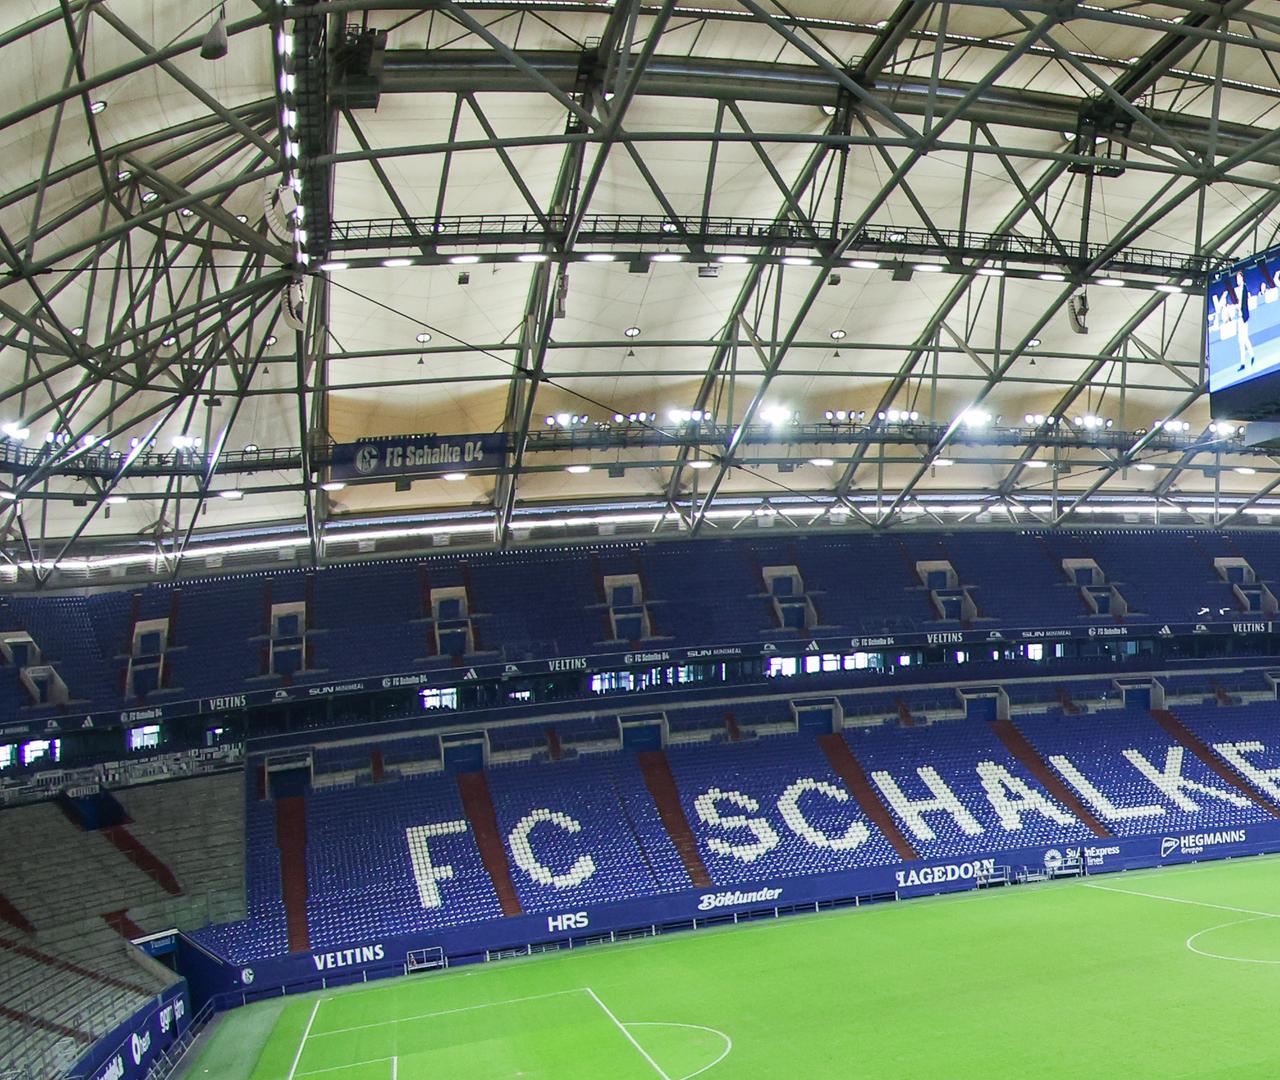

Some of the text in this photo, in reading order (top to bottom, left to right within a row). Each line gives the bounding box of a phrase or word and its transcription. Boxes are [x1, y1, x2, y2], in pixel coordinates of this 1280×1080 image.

[385, 440, 484, 468] FC Schalke 04
[1232, 623, 1266, 632] VELTINS
[927, 632, 963, 644] VELTINS
[549, 658, 587, 672] VELTINS
[308, 686, 334, 697] SUN
[210, 695, 247, 711] VELTINS
[1180, 829, 1246, 848] HEGMANNS
[405, 808, 596, 909] FC
[1181, 846, 1204, 855] Gruppe
[699, 886, 783, 911] Böklunder
[547, 911, 589, 932] HRS
[313, 944, 385, 971] VELTINS
